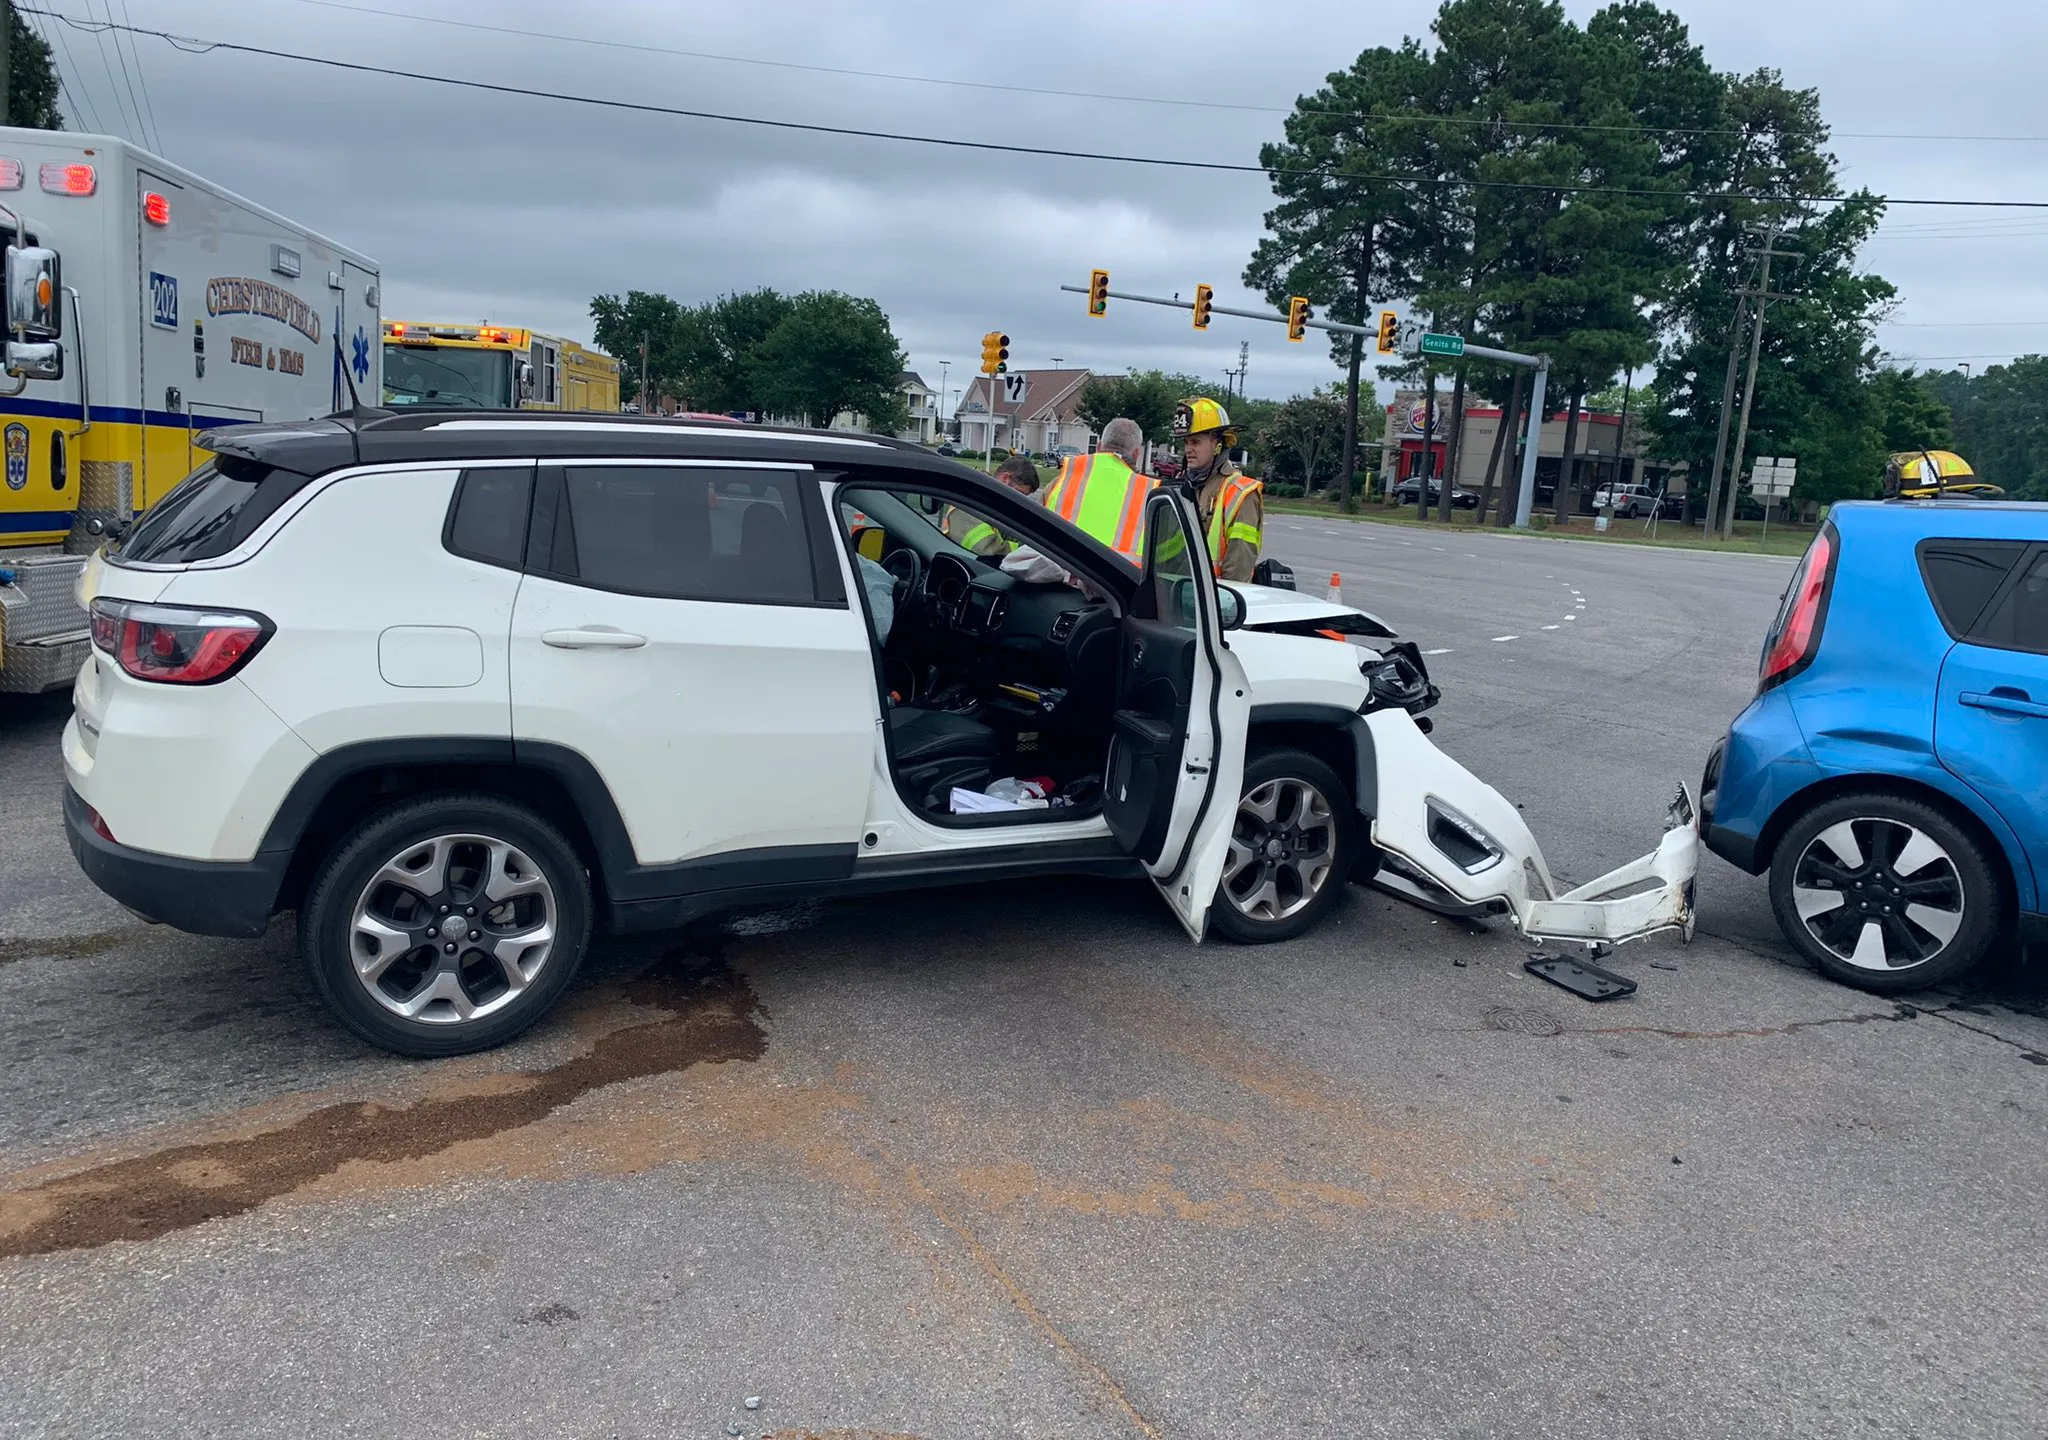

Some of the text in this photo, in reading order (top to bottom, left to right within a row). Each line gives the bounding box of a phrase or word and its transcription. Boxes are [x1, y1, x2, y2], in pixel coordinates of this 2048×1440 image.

[154, 279, 176, 320] 202
[206, 277, 322, 345] CHESTERFIELD
[231, 335, 263, 368] FIRE
[267, 347, 276, 371] &
[279, 348, 305, 376] EMS
[1425, 338, 1462, 350] Genito Rd
[1174, 413, 1188, 428] 24
